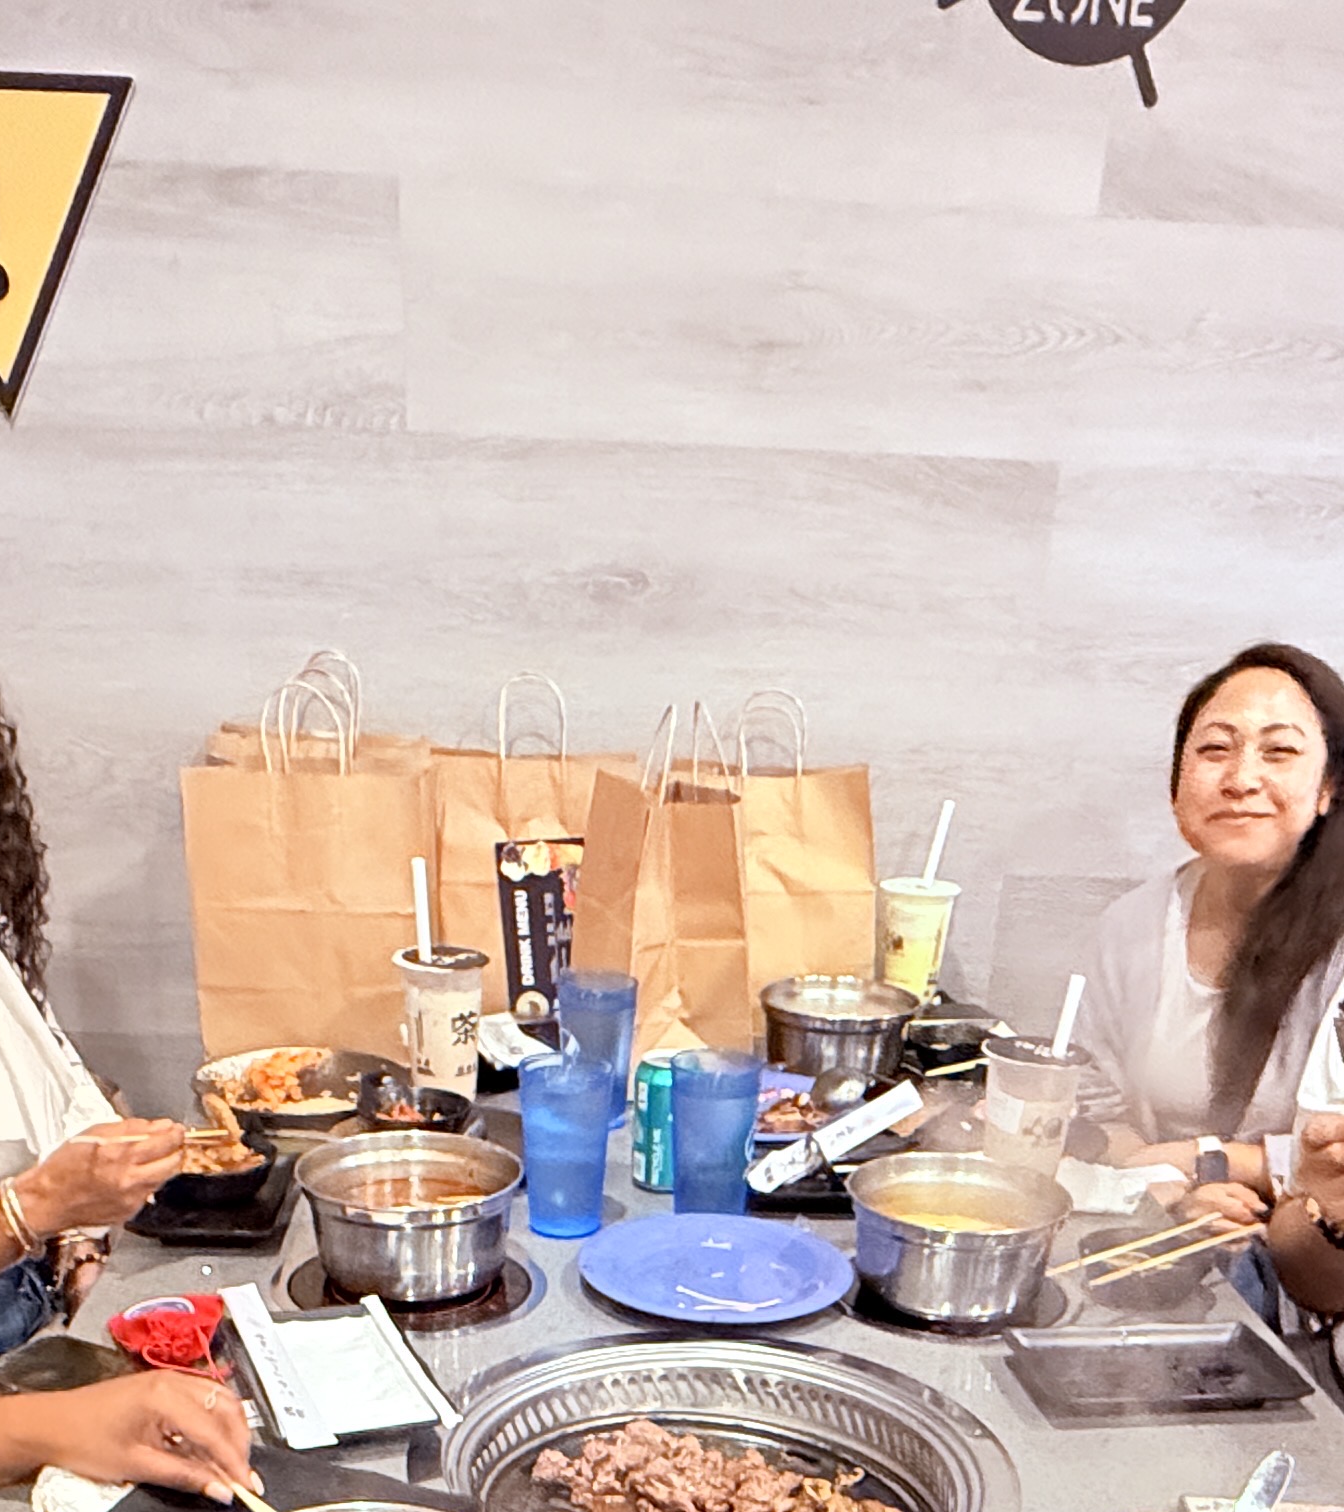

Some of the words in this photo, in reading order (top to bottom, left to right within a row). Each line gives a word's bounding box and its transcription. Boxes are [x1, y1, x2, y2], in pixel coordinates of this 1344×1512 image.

[513, 889, 531, 936] MENU
[519, 937, 535, 986] DRINK
[450, 1010, 478, 1047] 茶
